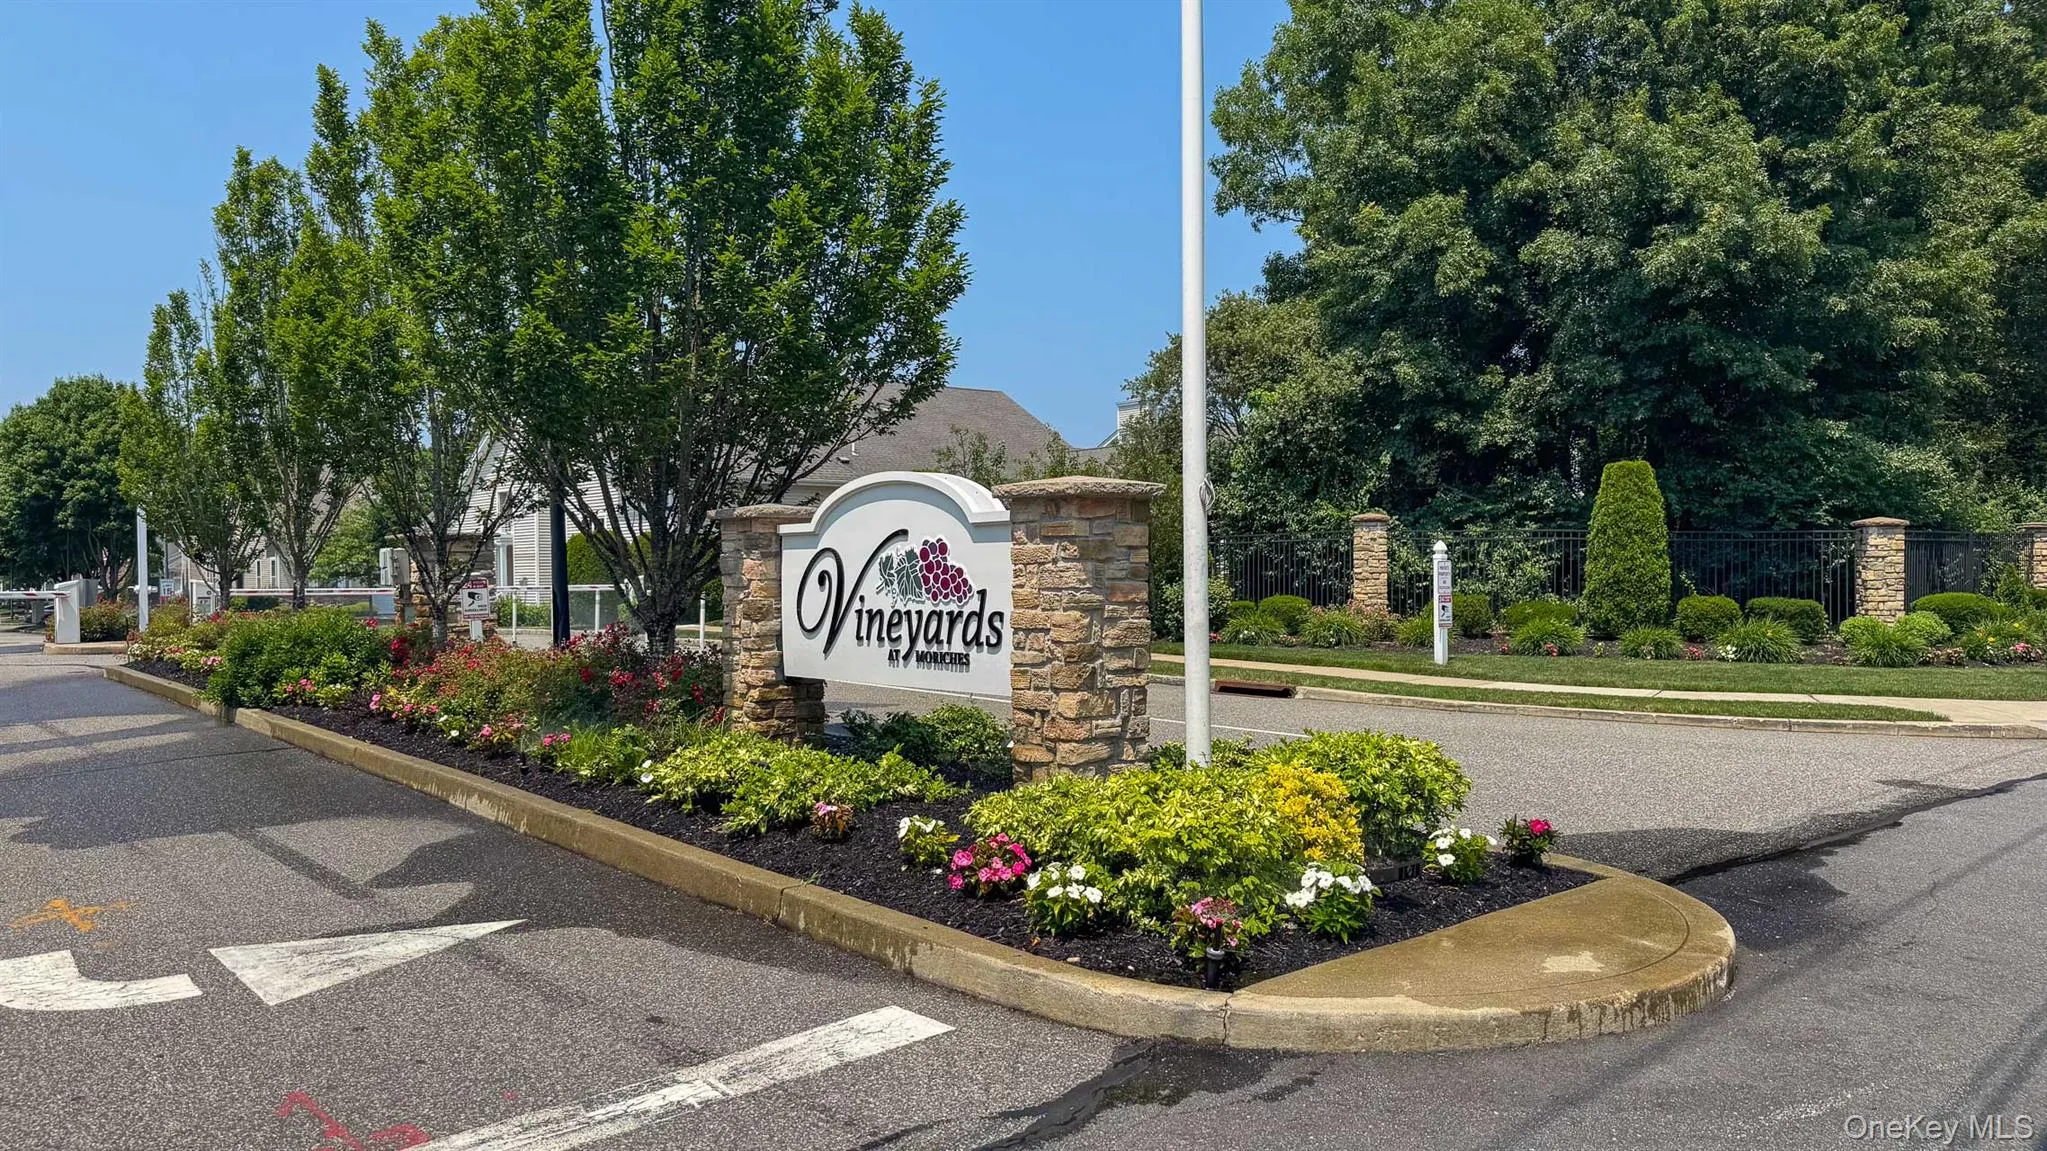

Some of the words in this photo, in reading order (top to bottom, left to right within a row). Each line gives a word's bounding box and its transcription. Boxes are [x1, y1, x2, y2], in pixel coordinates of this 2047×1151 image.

[797, 528, 1005, 660] Vineyards
[888, 649, 901, 661] AT
[915, 650, 971, 666] MORICHES
